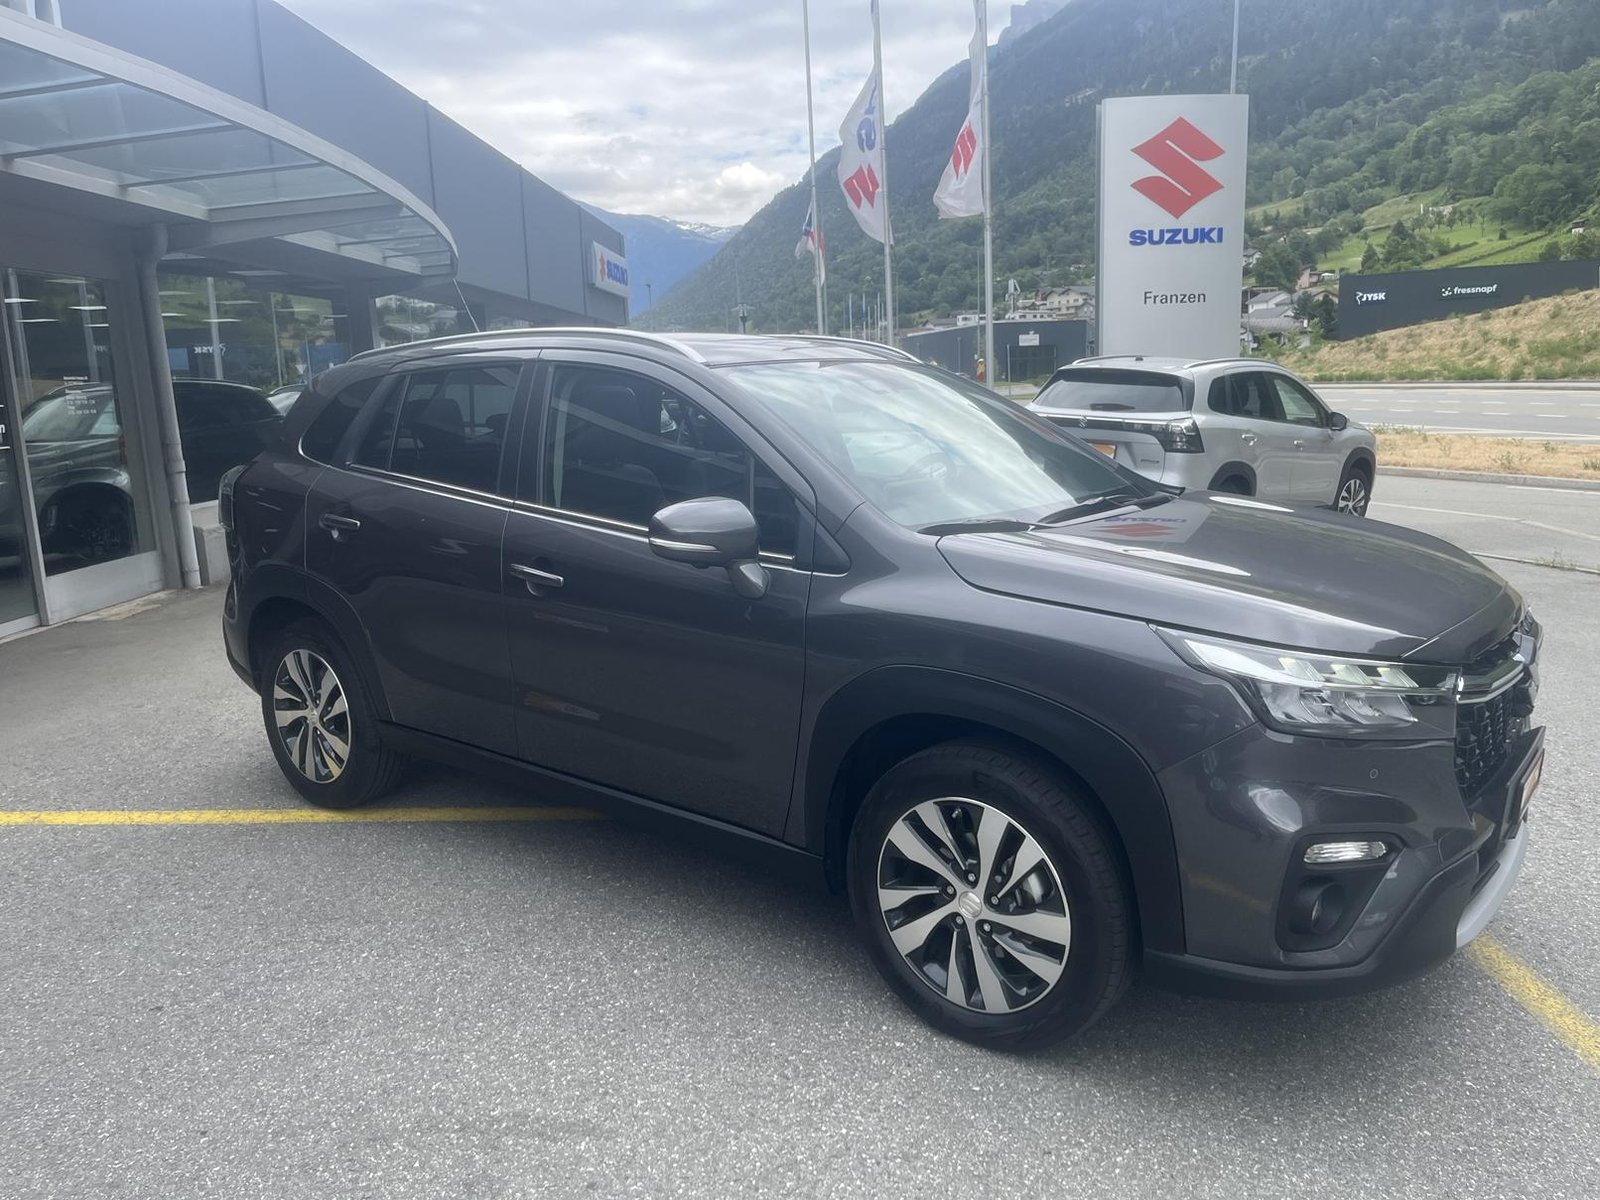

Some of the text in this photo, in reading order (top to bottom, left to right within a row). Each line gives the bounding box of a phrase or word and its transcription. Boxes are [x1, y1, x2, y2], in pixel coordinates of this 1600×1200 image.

[1129, 227, 1224, 246] SUZUKI
[1453, 284, 1498, 295] fressnapf
[1143, 291, 1207, 304] Franzen
[1361, 292, 1386, 301] JYSK
